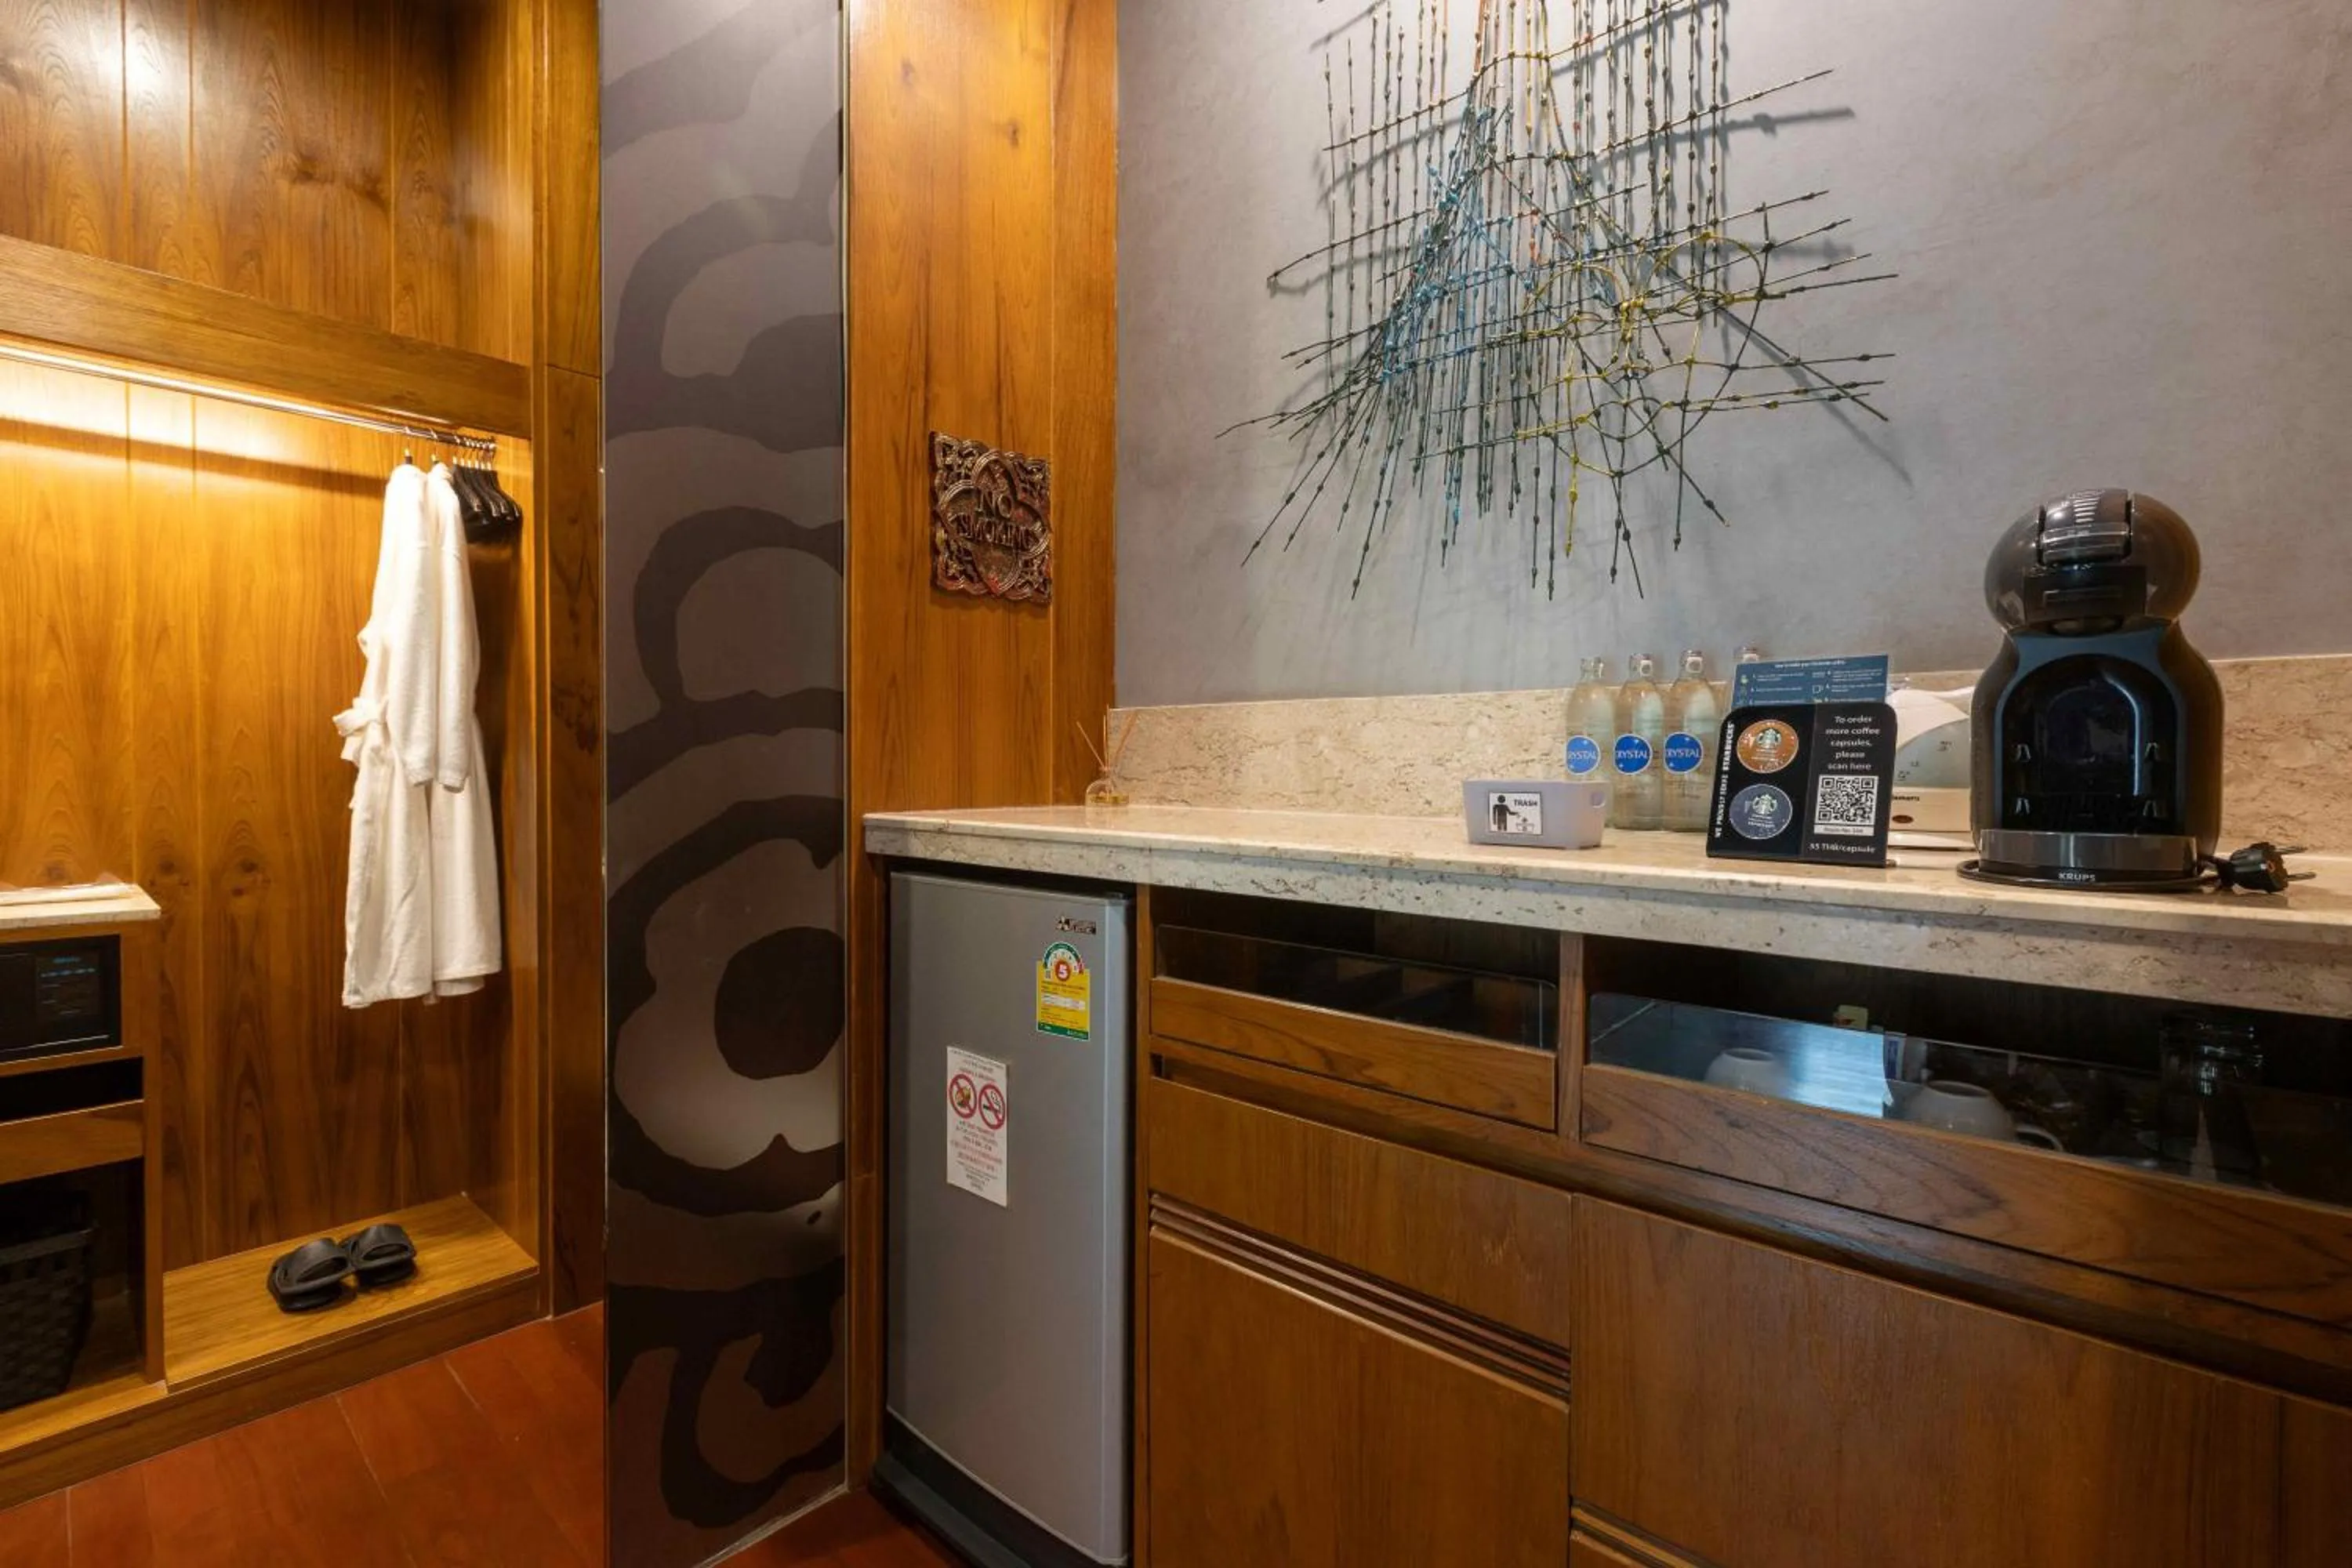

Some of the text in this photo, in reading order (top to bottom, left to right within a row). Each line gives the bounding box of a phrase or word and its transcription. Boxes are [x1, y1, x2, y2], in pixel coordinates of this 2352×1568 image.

[975, 490, 1014, 518] NO
[955, 513, 1035, 550] SMOKING
[1835, 714, 1872, 724] To order
[1835, 750, 1865, 759] please
[1850, 762, 1871, 771] here
[1514, 798, 1537, 807] TRASH
[2058, 873, 2096, 882] KRUPS
[1060, 963, 1068, 978] 5
